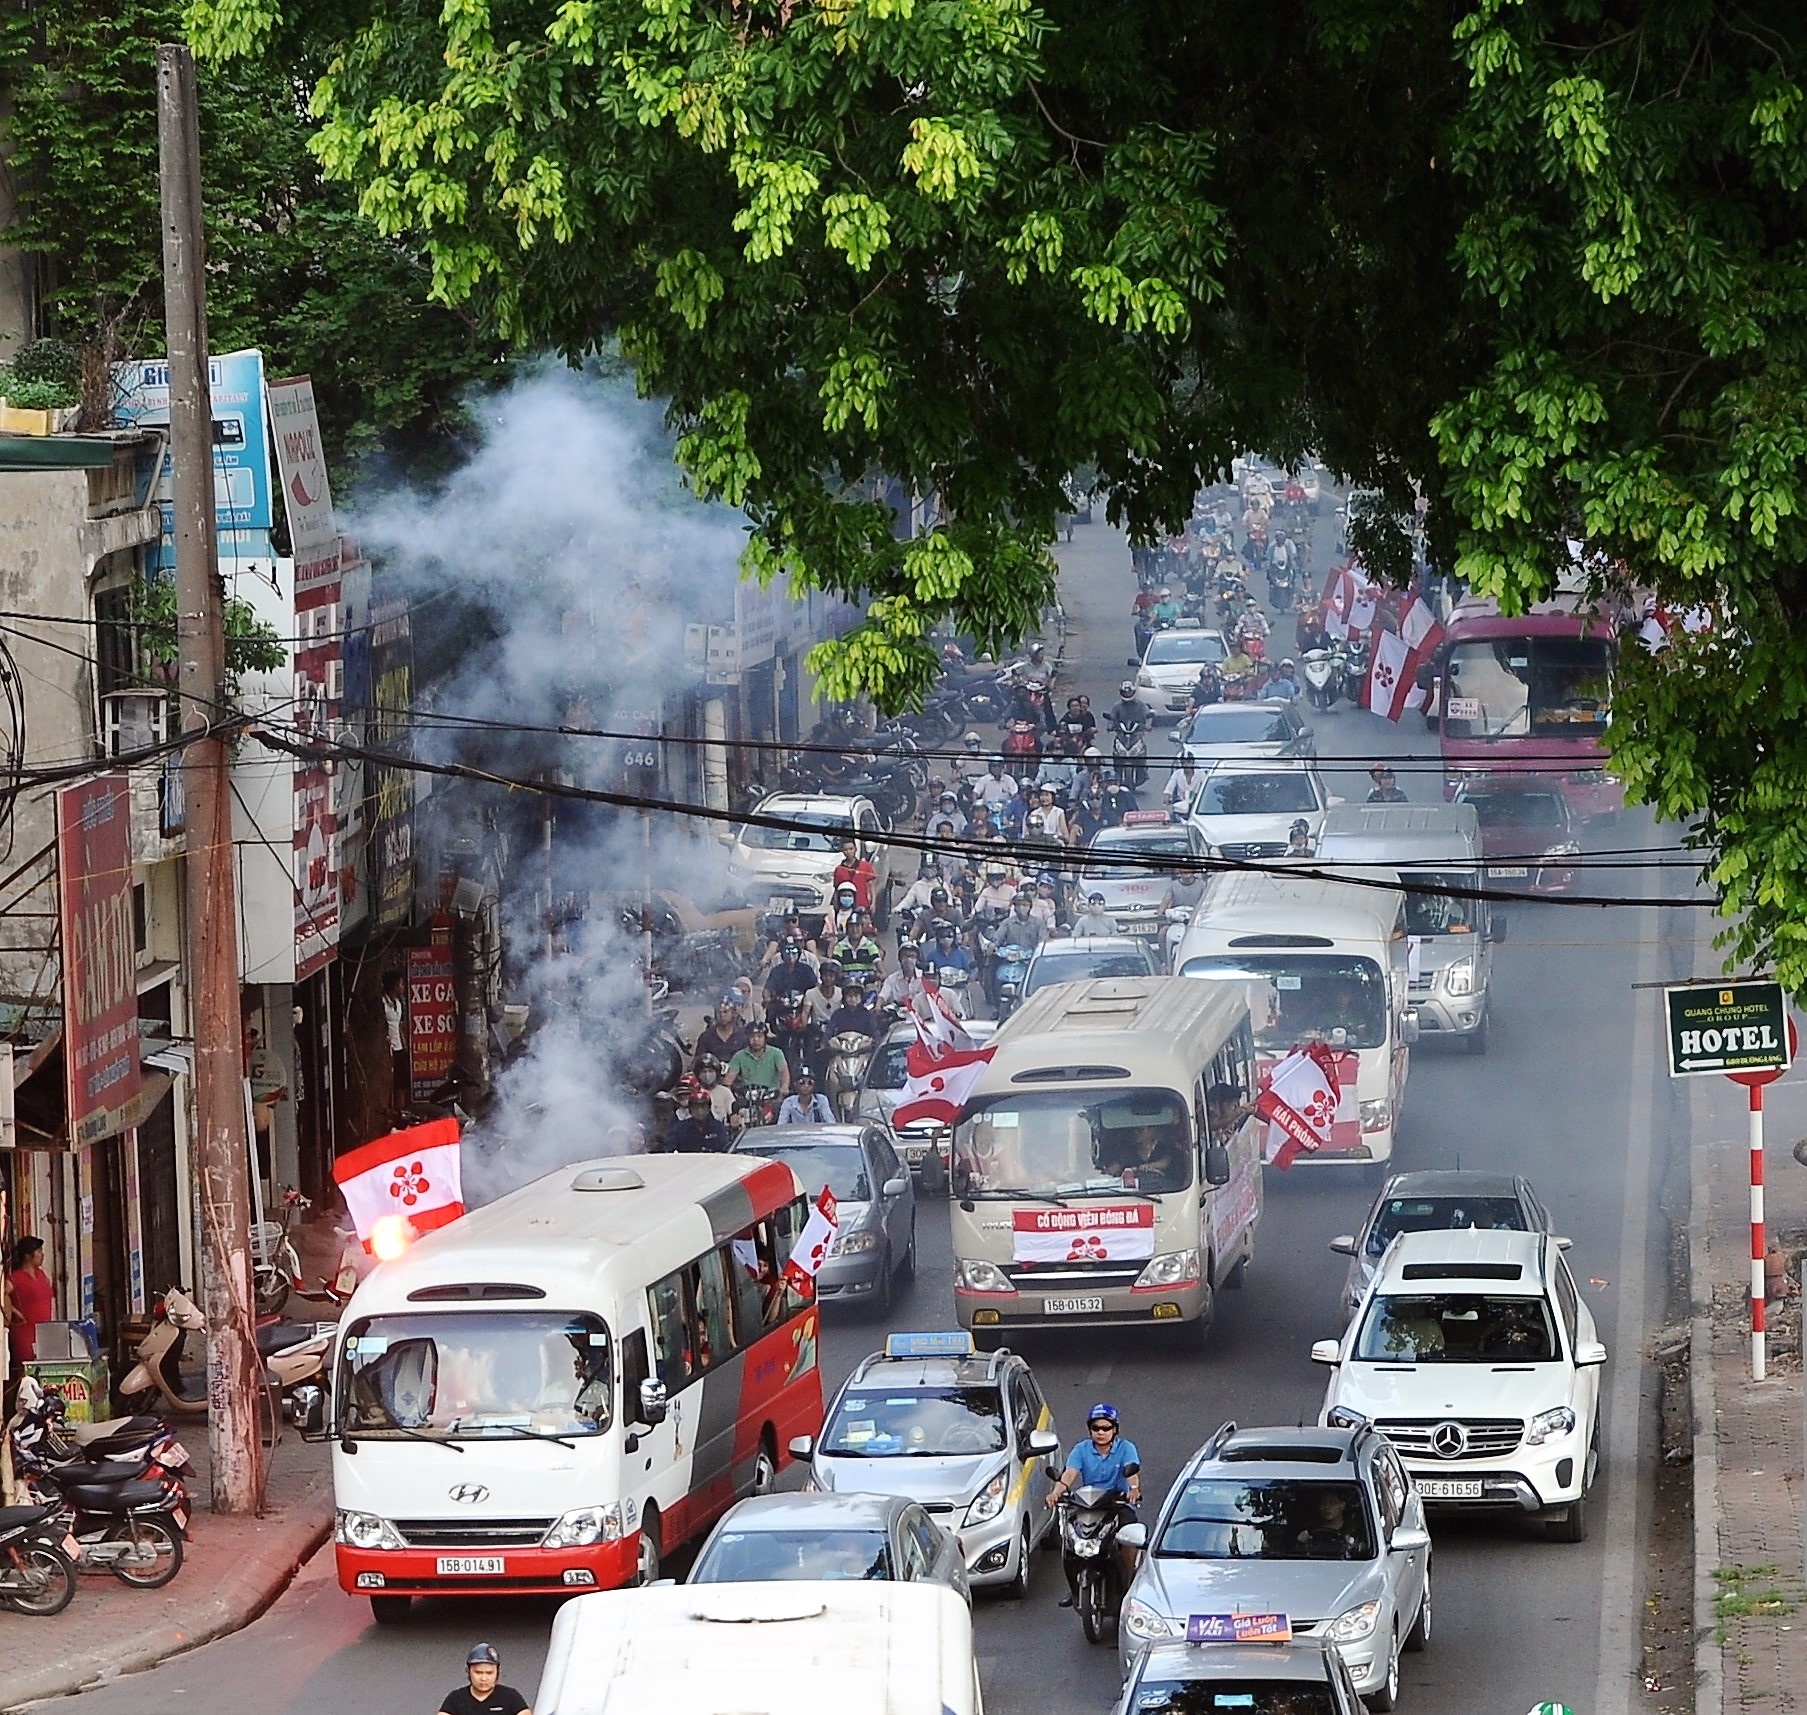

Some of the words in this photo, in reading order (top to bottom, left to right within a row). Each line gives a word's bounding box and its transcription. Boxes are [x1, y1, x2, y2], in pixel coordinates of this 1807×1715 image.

[624, 751, 655, 766] 646
[411, 984, 431, 1003] XE
[435, 983, 456, 1002] GA
[1714, 1005, 1743, 1015] CHUNG
[1743, 1003, 1770, 1014] HOTEL
[413, 1014, 433, 1034] XE
[1706, 1013, 1750, 1022] GROUP
[1680, 1025, 1778, 1054] HOTEL
[1417, 1482, 1479, 1495] 30E-616.56
[441, 1559, 501, 1572] 15B-014.91
